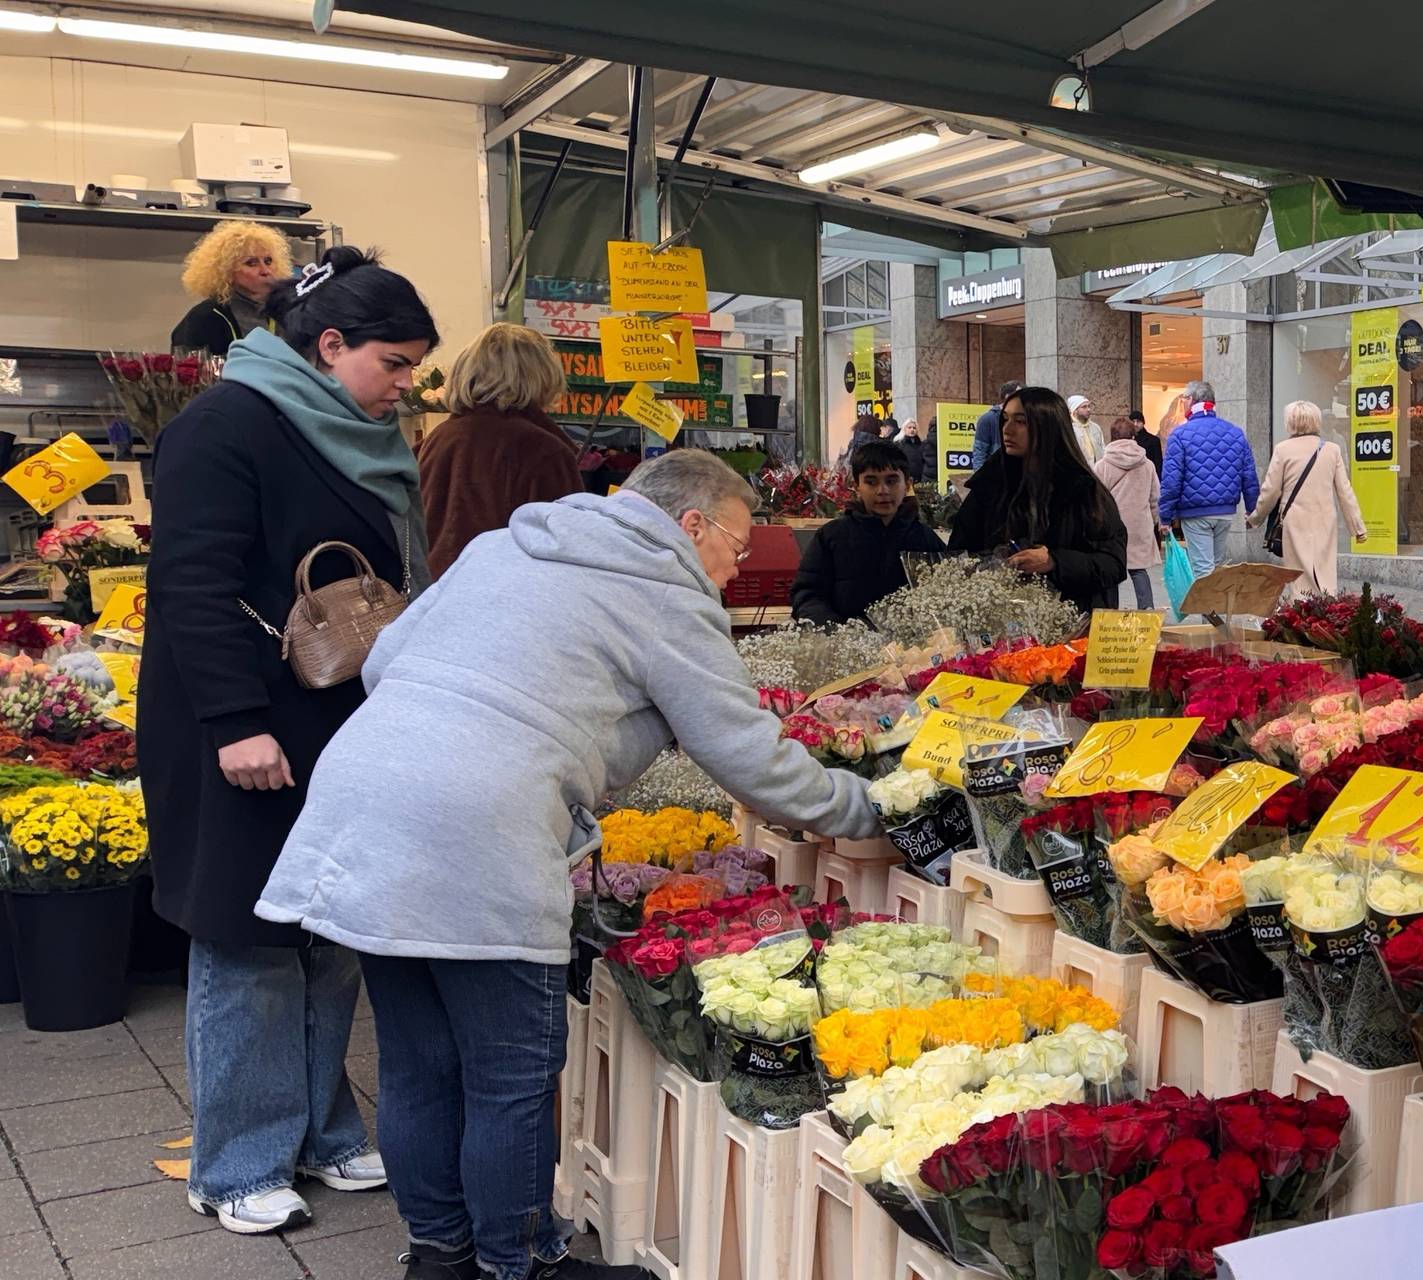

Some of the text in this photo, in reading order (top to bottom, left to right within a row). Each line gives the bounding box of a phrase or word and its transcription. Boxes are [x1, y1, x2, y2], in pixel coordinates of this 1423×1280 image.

[620, 318, 661, 330] BITTE
[621, 333, 661, 343] UNTEN
[620, 346, 664, 357] STEHEN
[1358, 342, 1391, 357] DEAL
[624, 361, 671, 373] BLEIBEN
[1357, 390, 1391, 412] 50€
[948, 421, 976, 431] DEA
[1357, 438, 1392, 455] 100€
[948, 453, 974, 467] 50
[922, 749, 952, 766] Bund
[1024, 754, 1058, 768] Rosa
[968, 775, 1004, 789] Plaza
[893, 829, 926, 850] Rosa
[908, 838, 945, 861] Plaza
[1050, 865, 1084, 883] Rosa
[1052, 874, 1092, 894] Plaza
[751, 1045, 777, 1060] Rosa
[749, 1053, 785, 1070] Plaza
